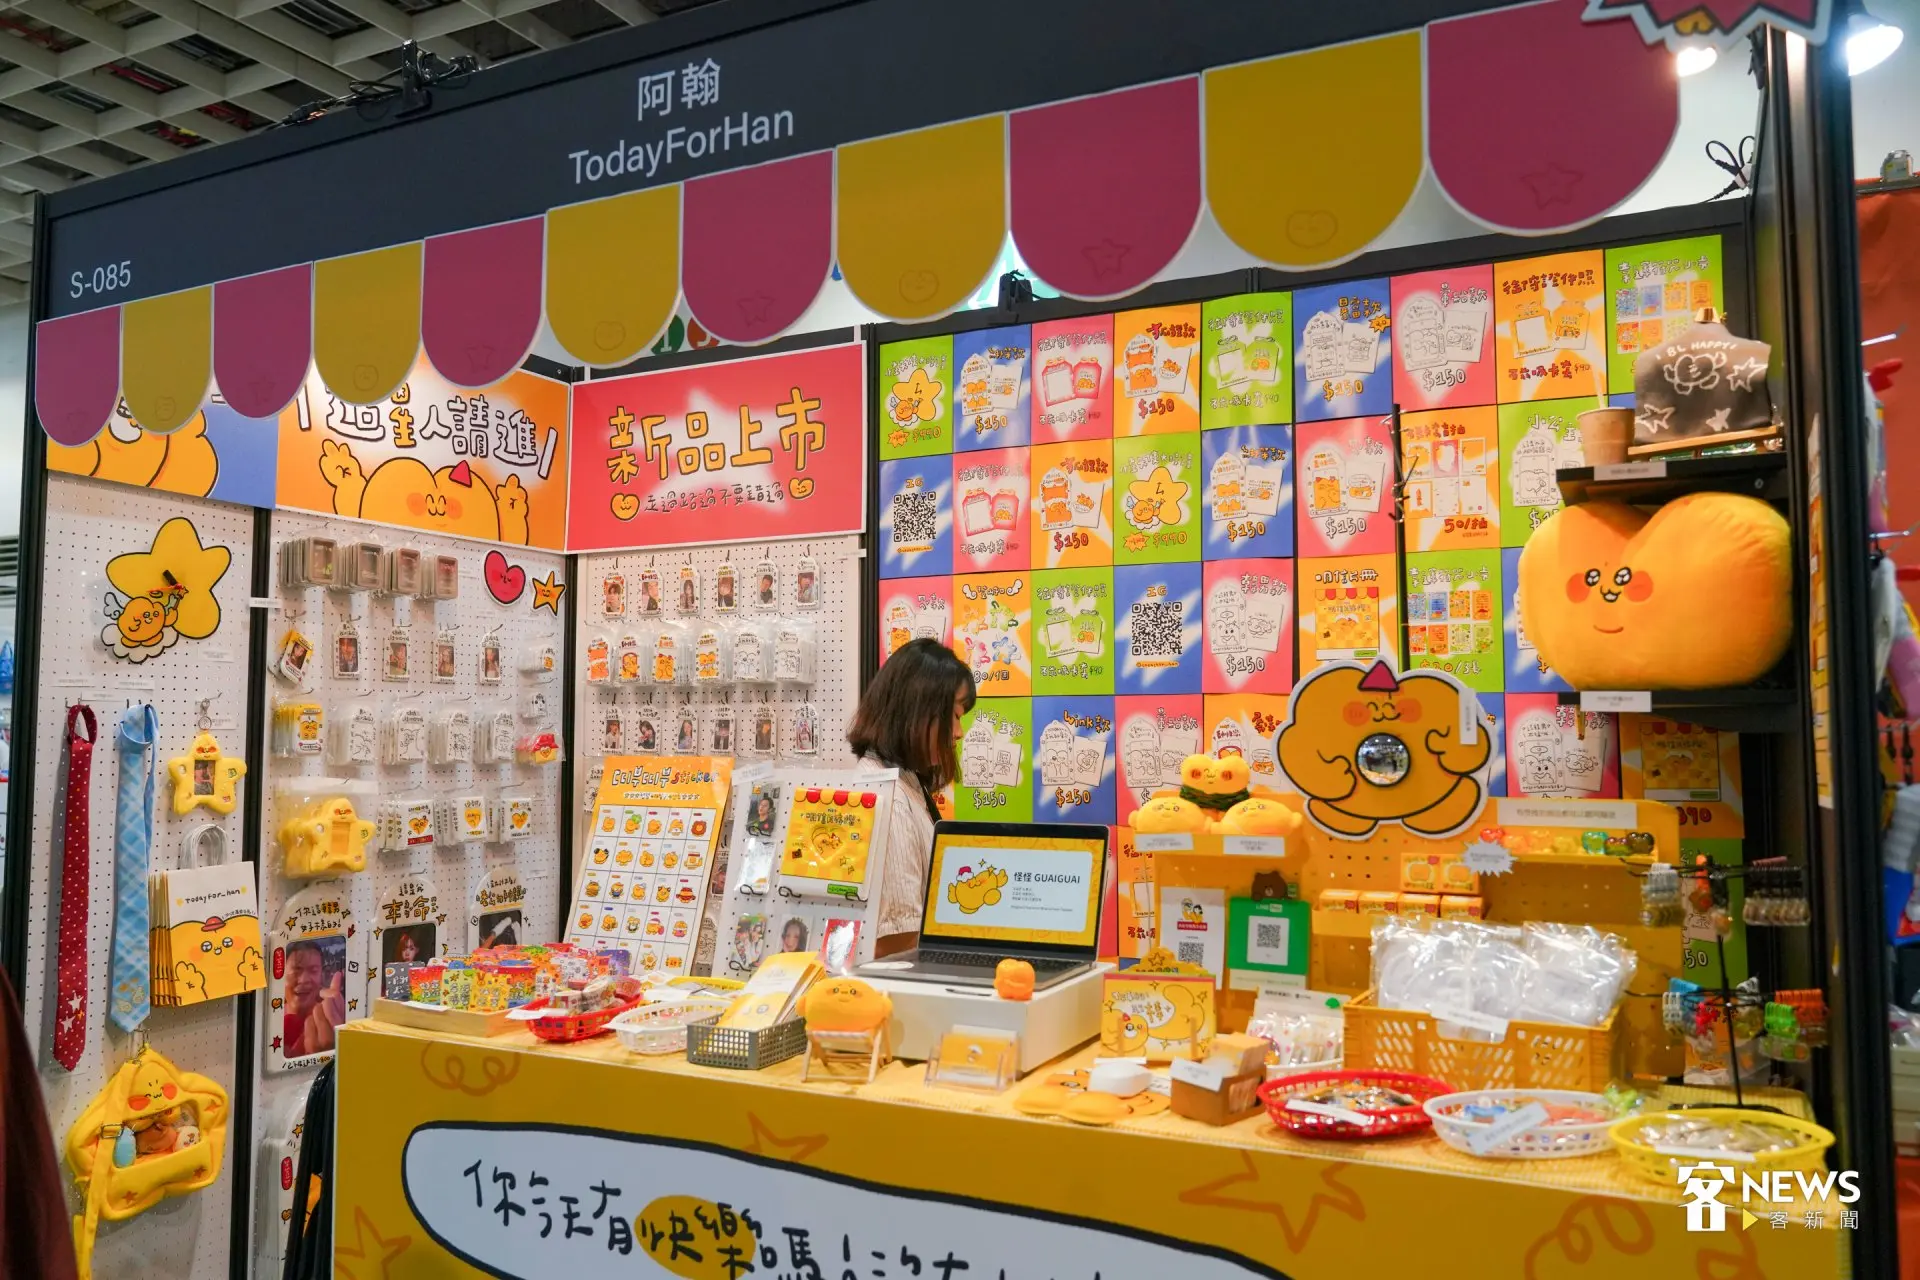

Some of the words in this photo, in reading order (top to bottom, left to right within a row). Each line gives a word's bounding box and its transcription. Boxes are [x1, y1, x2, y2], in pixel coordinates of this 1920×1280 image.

[638, 57, 721, 122] 阿翰
[568, 109, 794, 185] TodayForHan
[70, 260, 131, 299] S-085
[1322, 379, 1364, 402] $150
[1423, 368, 1466, 392] $150
[1138, 398, 1175, 419] $150
[607, 386, 826, 485] 新品上市
[975, 415, 1008, 434] $150
[1528, 413, 1582, 442] 小公主
[905, 477, 924, 489] IG
[645, 481, 784, 513] 走過路過不要錯過
[1226, 520, 1266, 543] $150
[1325, 516, 1367, 540] $150
[1053, 531, 1089, 553] $150
[1146, 584, 1168, 598] IG
[1225, 654, 1266, 676] $150
[973, 789, 1007, 810] $150
[1055, 786, 1091, 808] $150
[1034, 873, 1081, 884] GUAIGUAI
